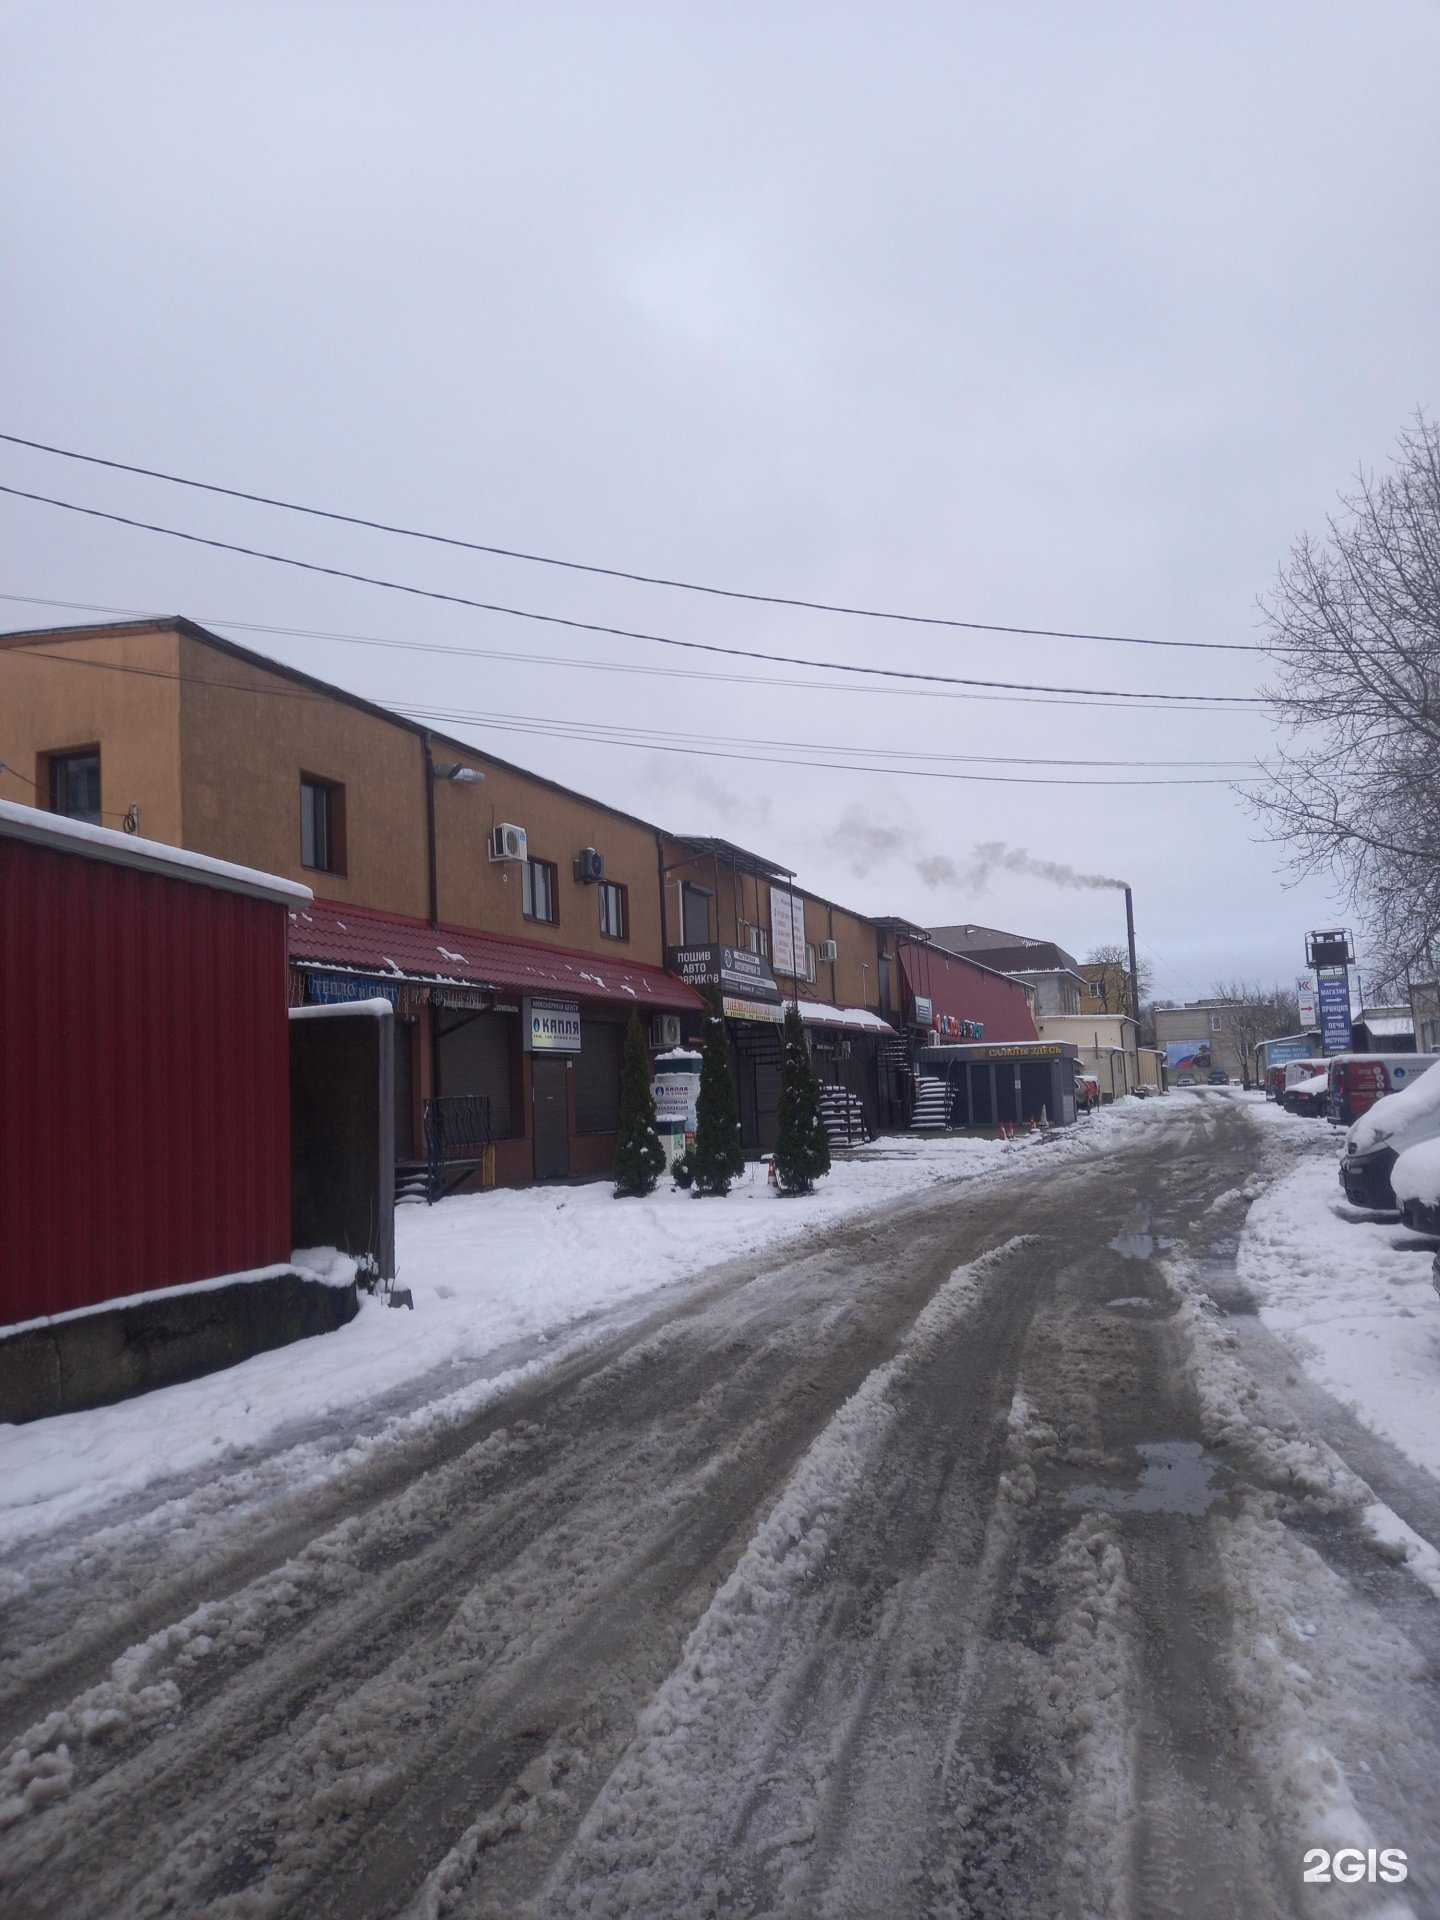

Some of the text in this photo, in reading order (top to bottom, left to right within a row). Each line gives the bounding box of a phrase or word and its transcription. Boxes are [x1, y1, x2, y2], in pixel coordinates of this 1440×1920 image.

[678, 951, 711, 962] ПОШИВ
[683, 962, 706, 974] АВТО
[1320, 988, 1347, 996] МАГАЗИН
[542, 1018, 579, 1035] КАПЛЯ
